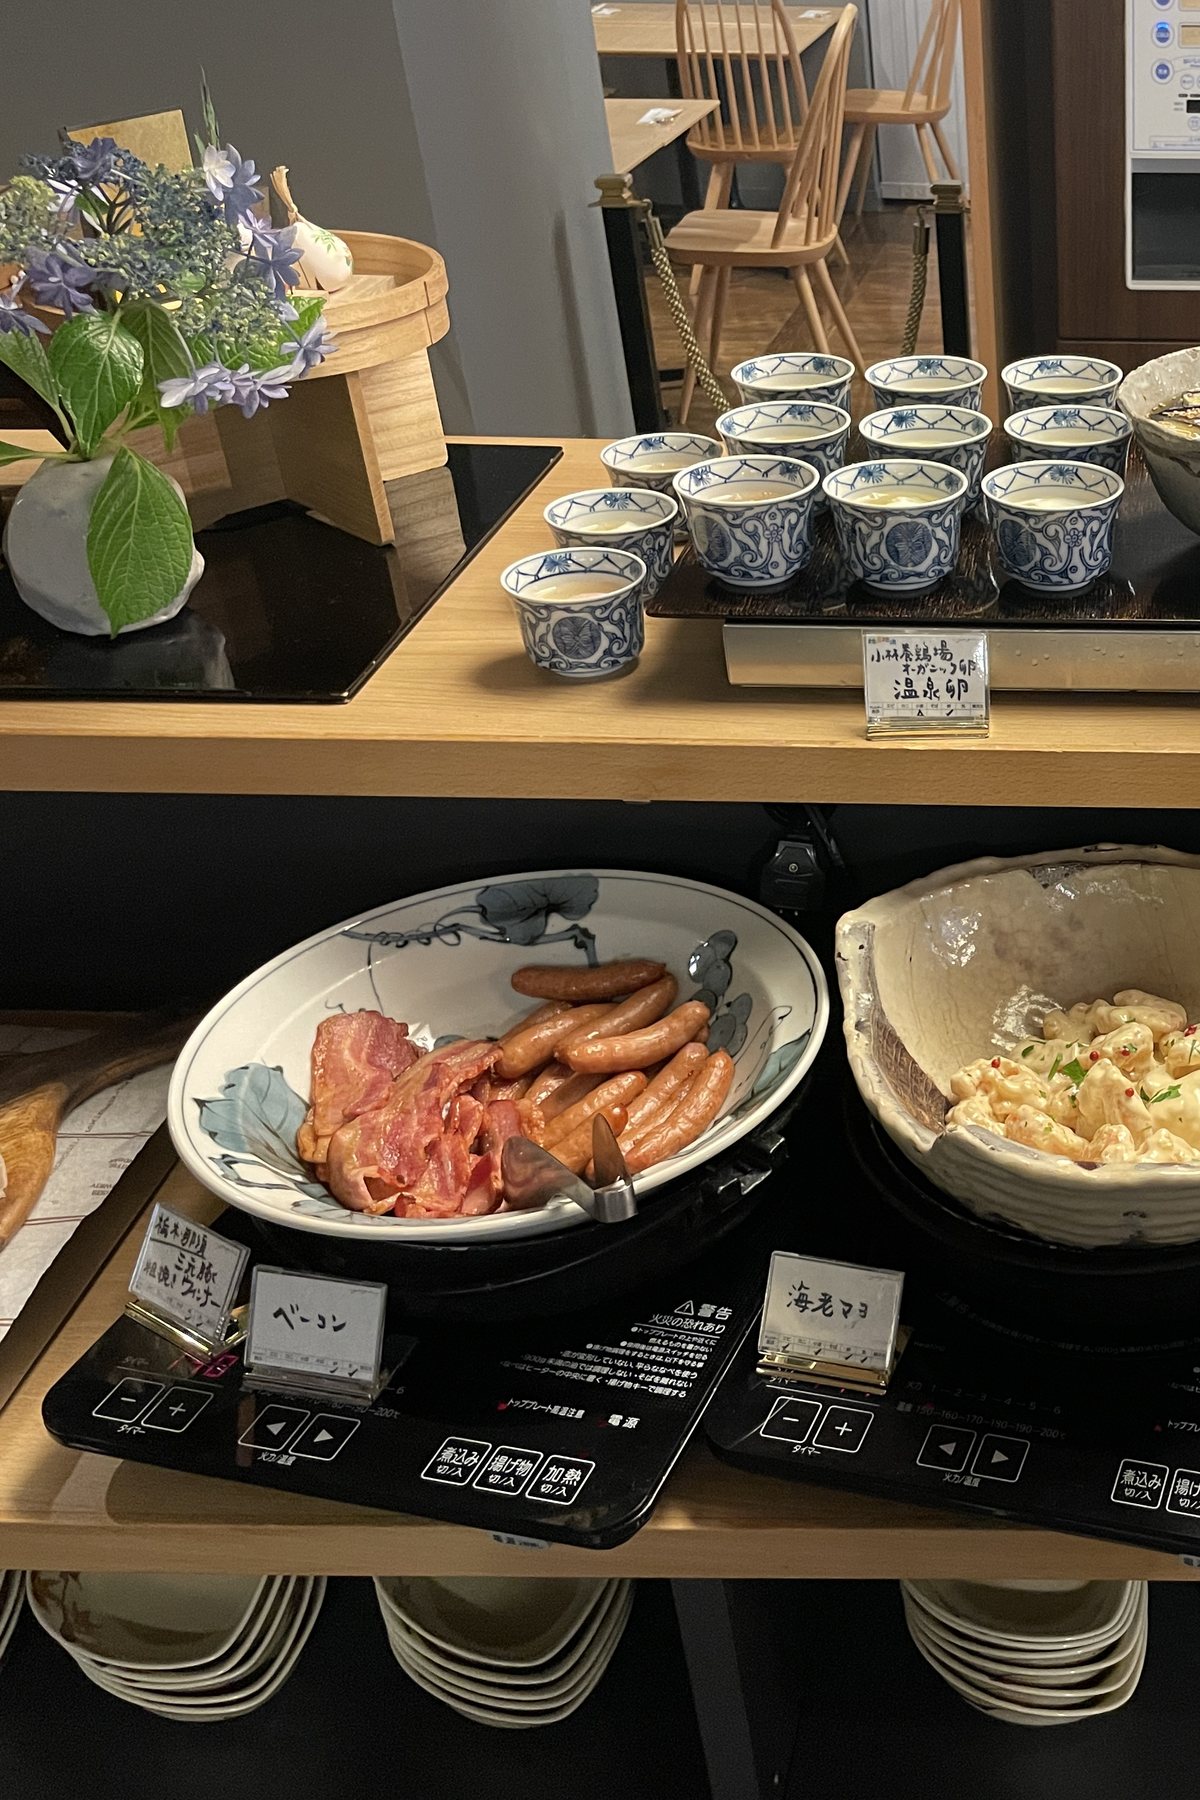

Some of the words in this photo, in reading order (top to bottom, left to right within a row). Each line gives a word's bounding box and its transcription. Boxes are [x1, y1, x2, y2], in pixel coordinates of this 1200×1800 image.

[893, 677, 969, 701] 温泉卵
[786, 1280, 868, 1319] 海老マヨ
[273, 1303, 346, 1332] ベーコン
[698, 1303, 732, 1320] 警告
[649, 1313, 726, 1334] 火災の恐れあり
[608, 1413, 641, 1428] 電源
[436, 1447, 480, 1467] 煮込み
[488, 1455, 533, 1477] 揚げ物
[436, 1464, 463, 1477] 切/入
[488, 1474, 515, 1487] 切/入
[542, 1465, 582, 1487] 加熱
[1120, 1469, 1162, 1490] 煮込み
[540, 1484, 567, 1497] 切/入
[1124, 1487, 1152, 1501] 切/入
